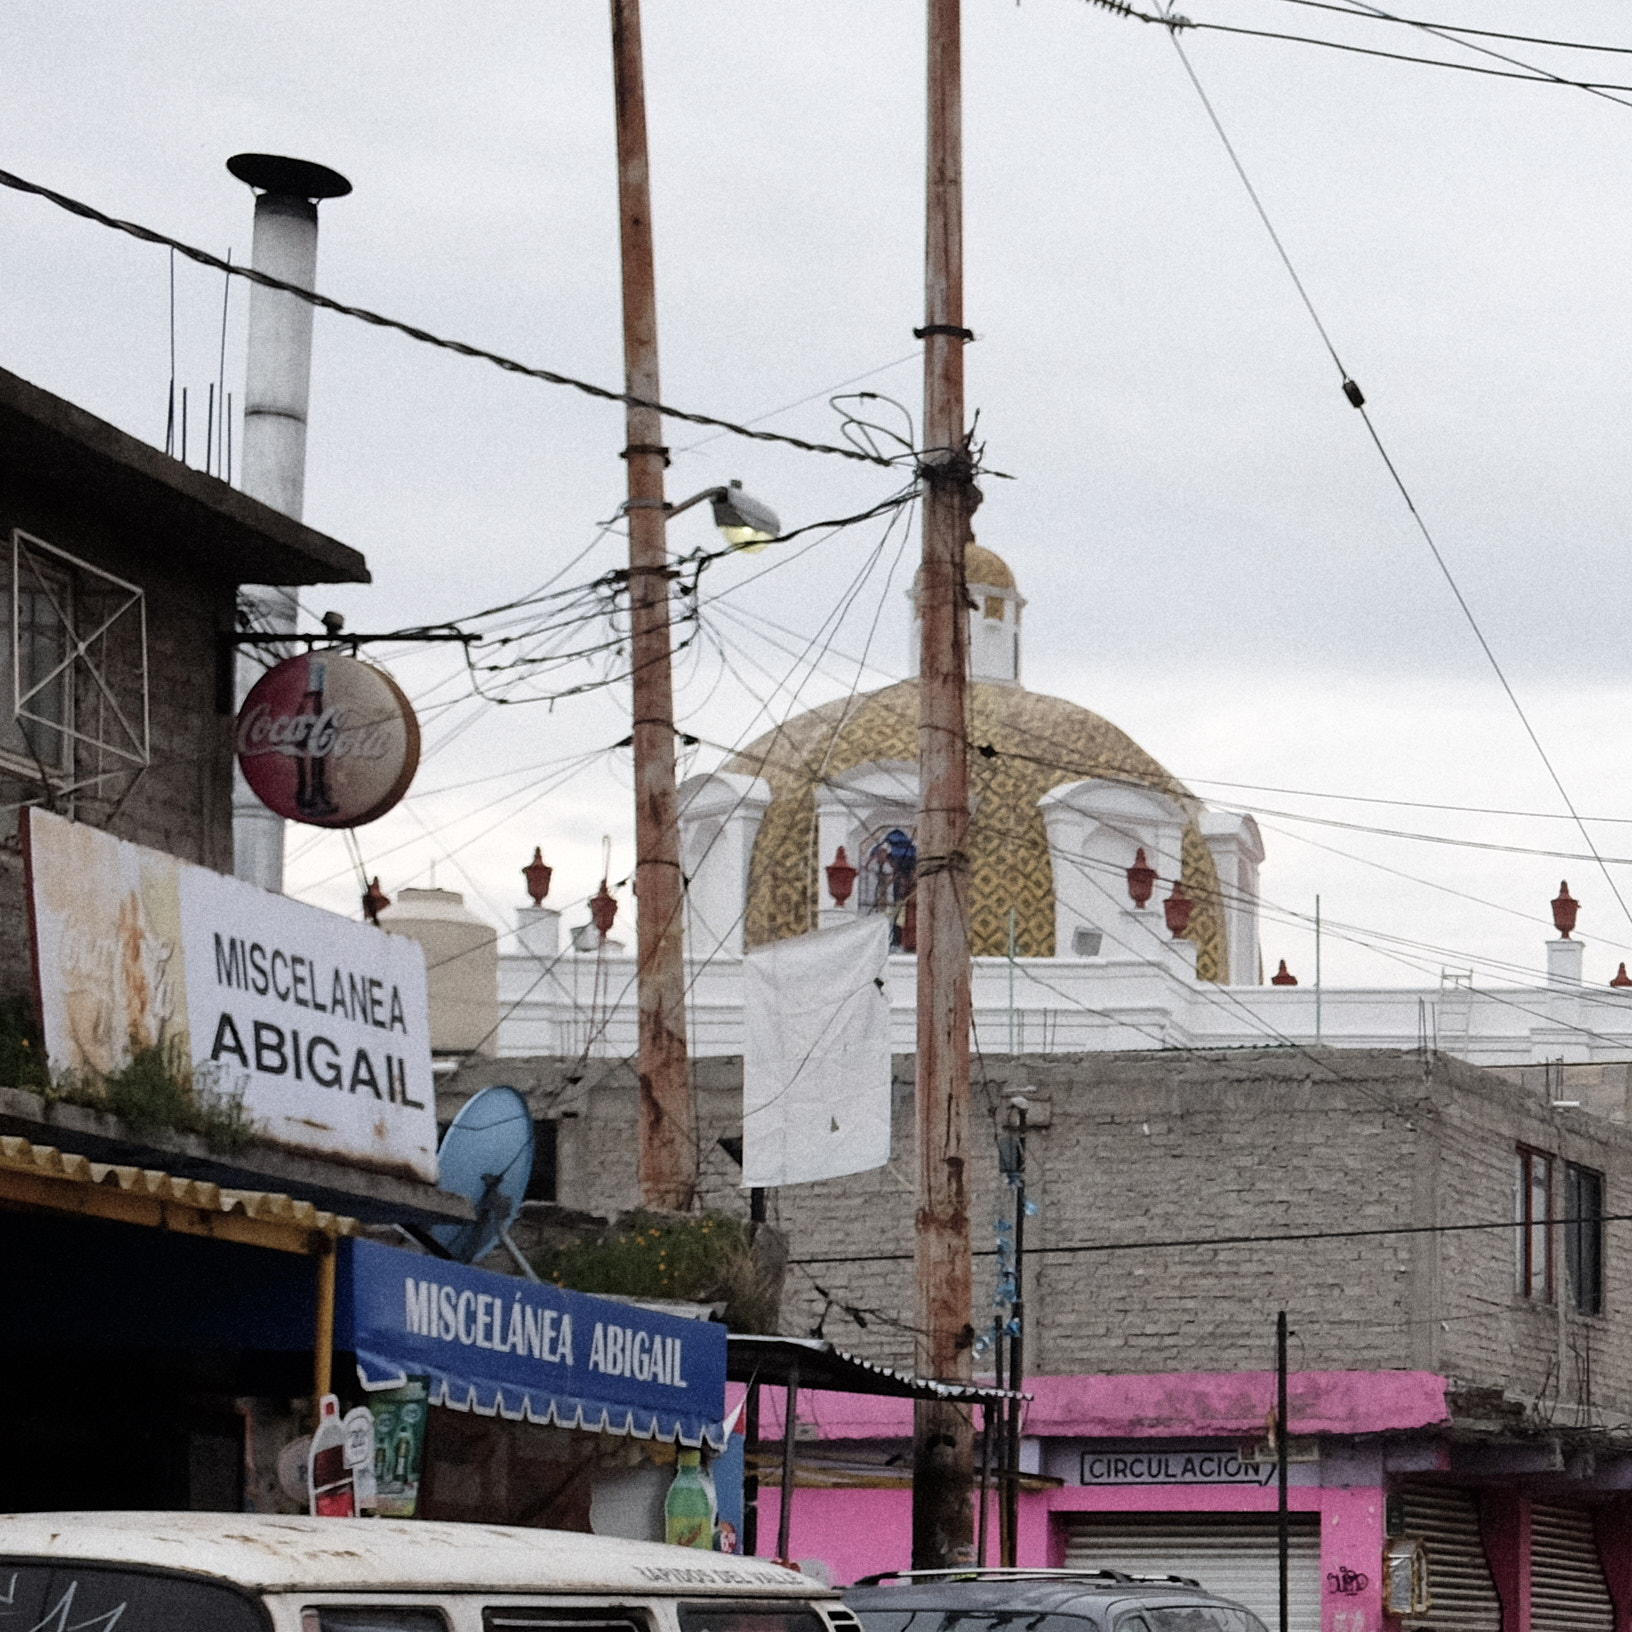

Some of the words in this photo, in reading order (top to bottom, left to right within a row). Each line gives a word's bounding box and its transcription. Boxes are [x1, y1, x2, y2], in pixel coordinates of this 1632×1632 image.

[213, 931, 408, 1035] MISCELANEA
[210, 1012, 426, 1110] ABIGAIL
[405, 1276, 574, 1367] MISCELÁNEA
[588, 1322, 688, 1389] ABIGAIL
[1089, 1456, 1261, 1479] CIRCULACION
